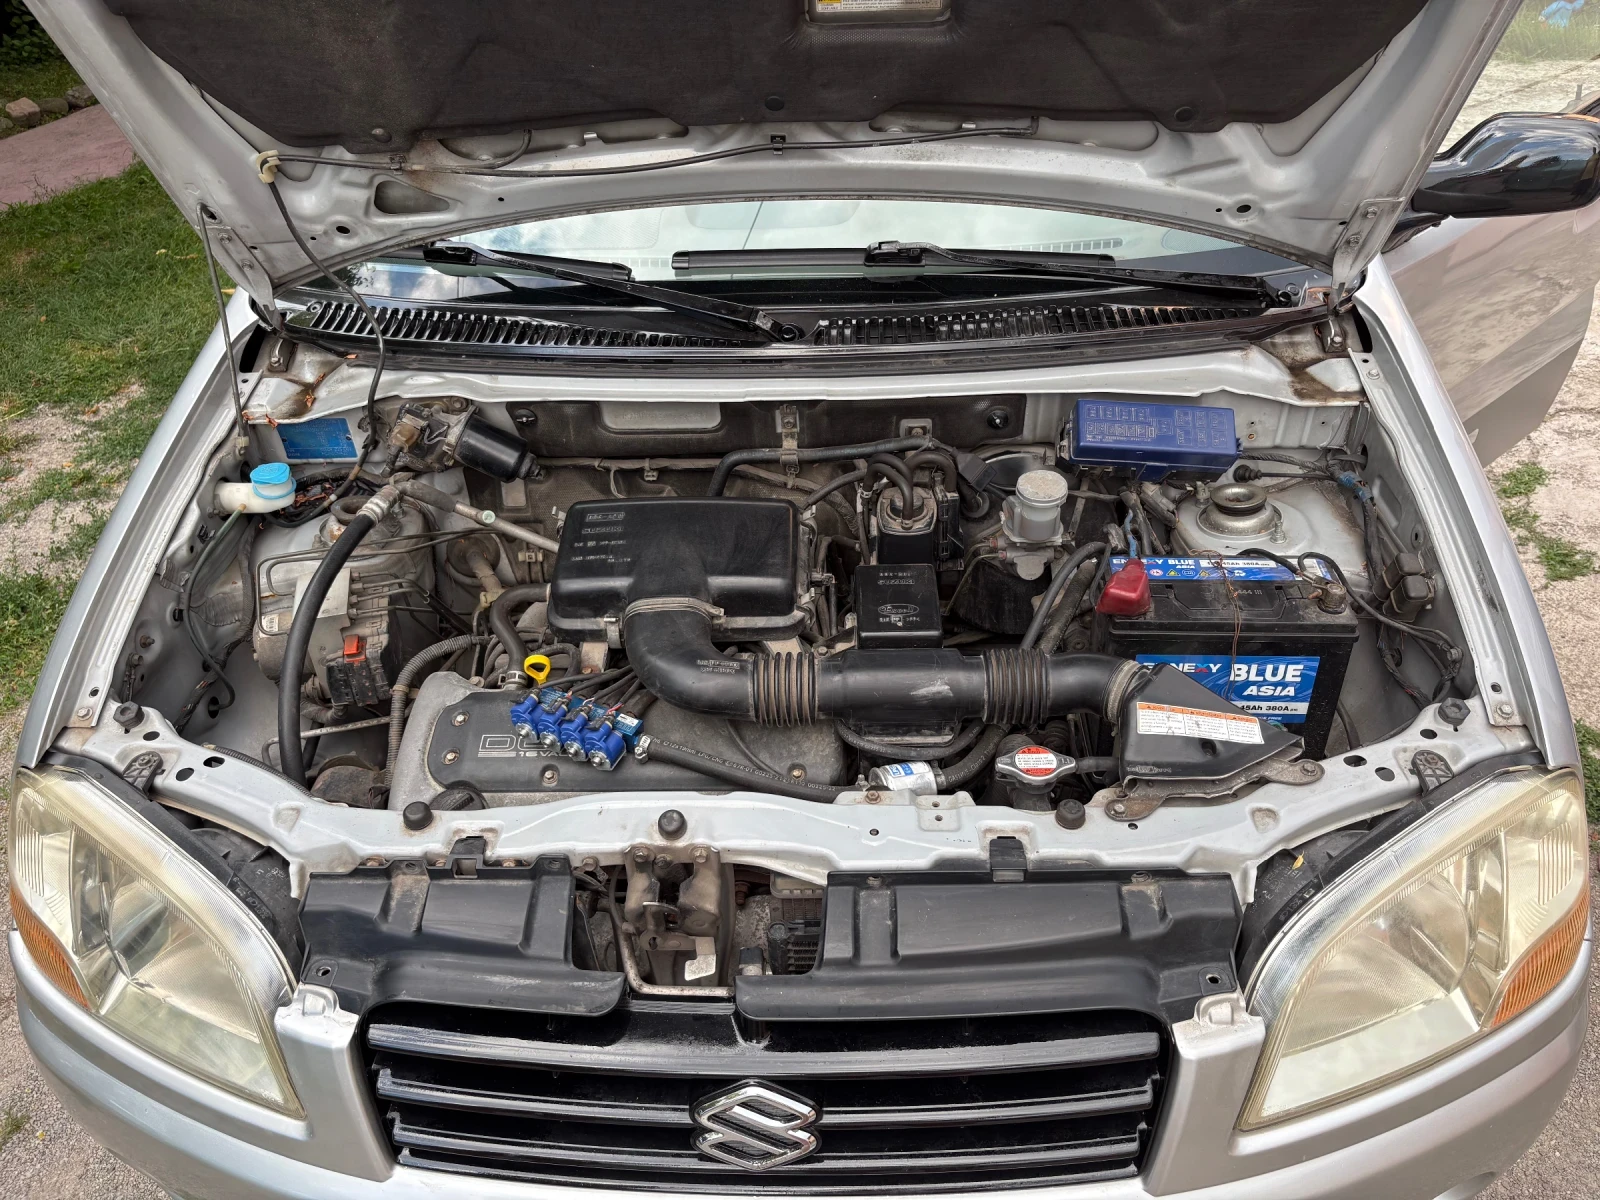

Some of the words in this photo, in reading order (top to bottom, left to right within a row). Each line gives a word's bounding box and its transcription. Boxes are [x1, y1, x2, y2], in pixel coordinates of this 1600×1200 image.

[1229, 663, 1304, 682] BLUE
[1242, 685, 1296, 696] ASIA
[1265, 705, 1290, 713] 380A
